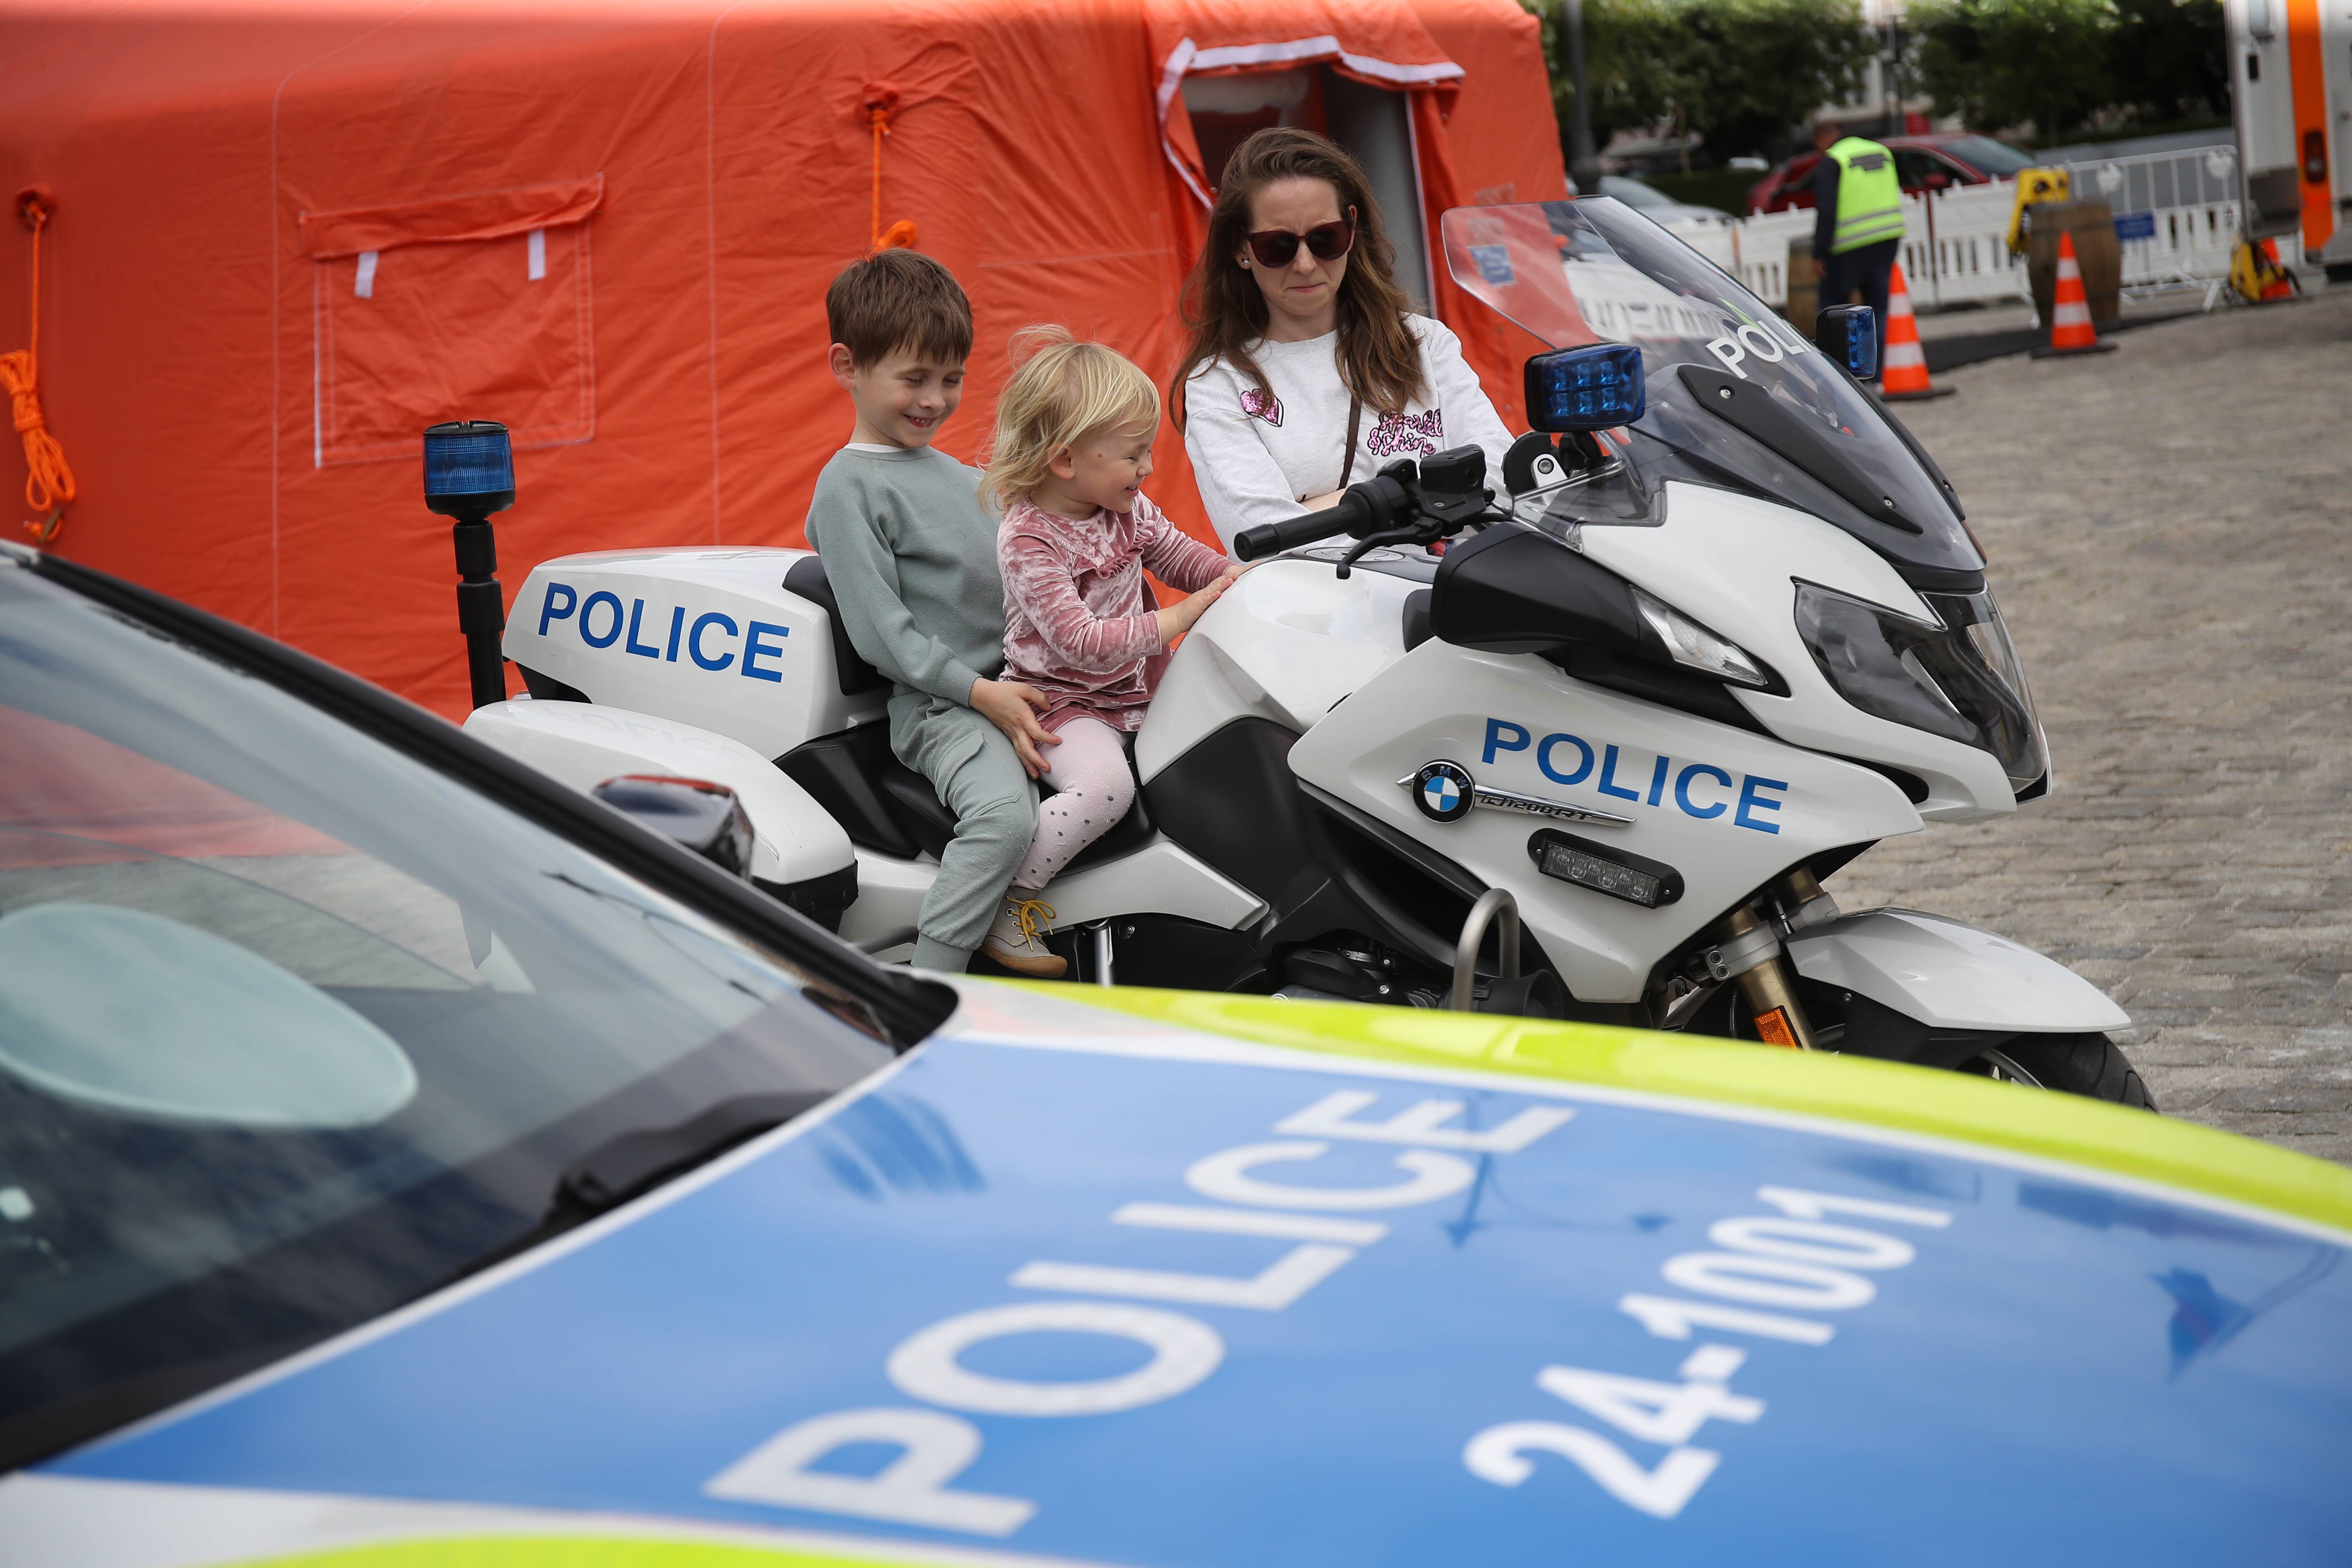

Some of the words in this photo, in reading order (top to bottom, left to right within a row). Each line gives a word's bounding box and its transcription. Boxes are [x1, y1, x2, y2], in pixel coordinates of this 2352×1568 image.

[538, 582, 790, 683] POLICE
[1421, 766, 1469, 789] BMW
[1482, 718, 1788, 835] POLICE
[704, 1088, 1578, 1537] POLICE
[1462, 1184, 1955, 1519] 24-1001
